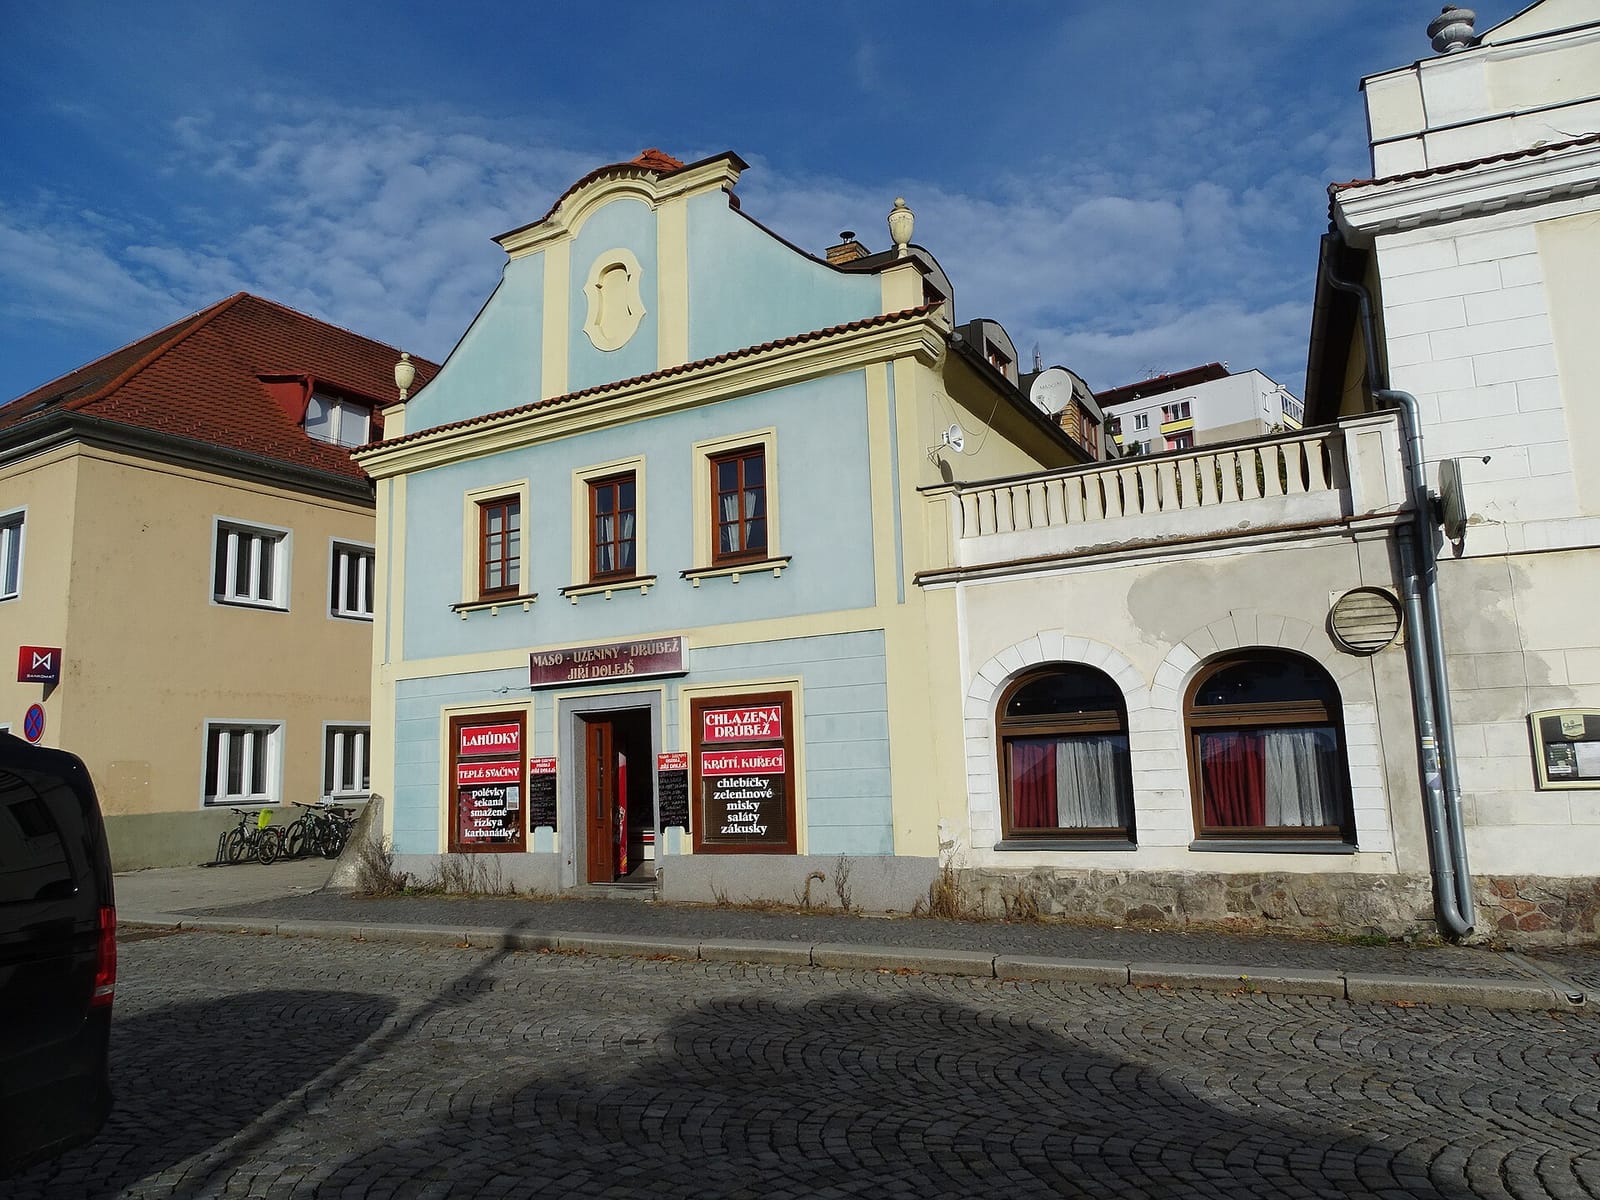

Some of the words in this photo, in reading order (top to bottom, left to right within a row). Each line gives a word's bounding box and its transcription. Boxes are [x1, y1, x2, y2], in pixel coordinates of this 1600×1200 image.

[532, 653, 563, 667] MASO
[573, 647, 620, 663] UZENINY
[567, 664, 589, 681] JIŘÍ
[591, 659, 635, 678] DOLEJŠ
[705, 709, 779, 726] CHLAZENÁ
[462, 731, 519, 747] LAHŮDKY
[741, 754, 783, 768] KUŘECÍ
[459, 767, 485, 779] TEPLÉ
[485, 766, 520, 778] SVAČINY
[717, 777, 769, 790] chlebíčky
[471, 787, 506, 798] polévky
[713, 788, 773, 800] zeleninové
[473, 798, 503, 807] sekaná
[726, 800, 760, 812] misky
[470, 808, 508, 817] smažené
[727, 811, 760, 825] saláty
[473, 817, 496, 829] řízky
[464, 827, 515, 838] karbanátky
[720, 824, 768, 836] zákusky
